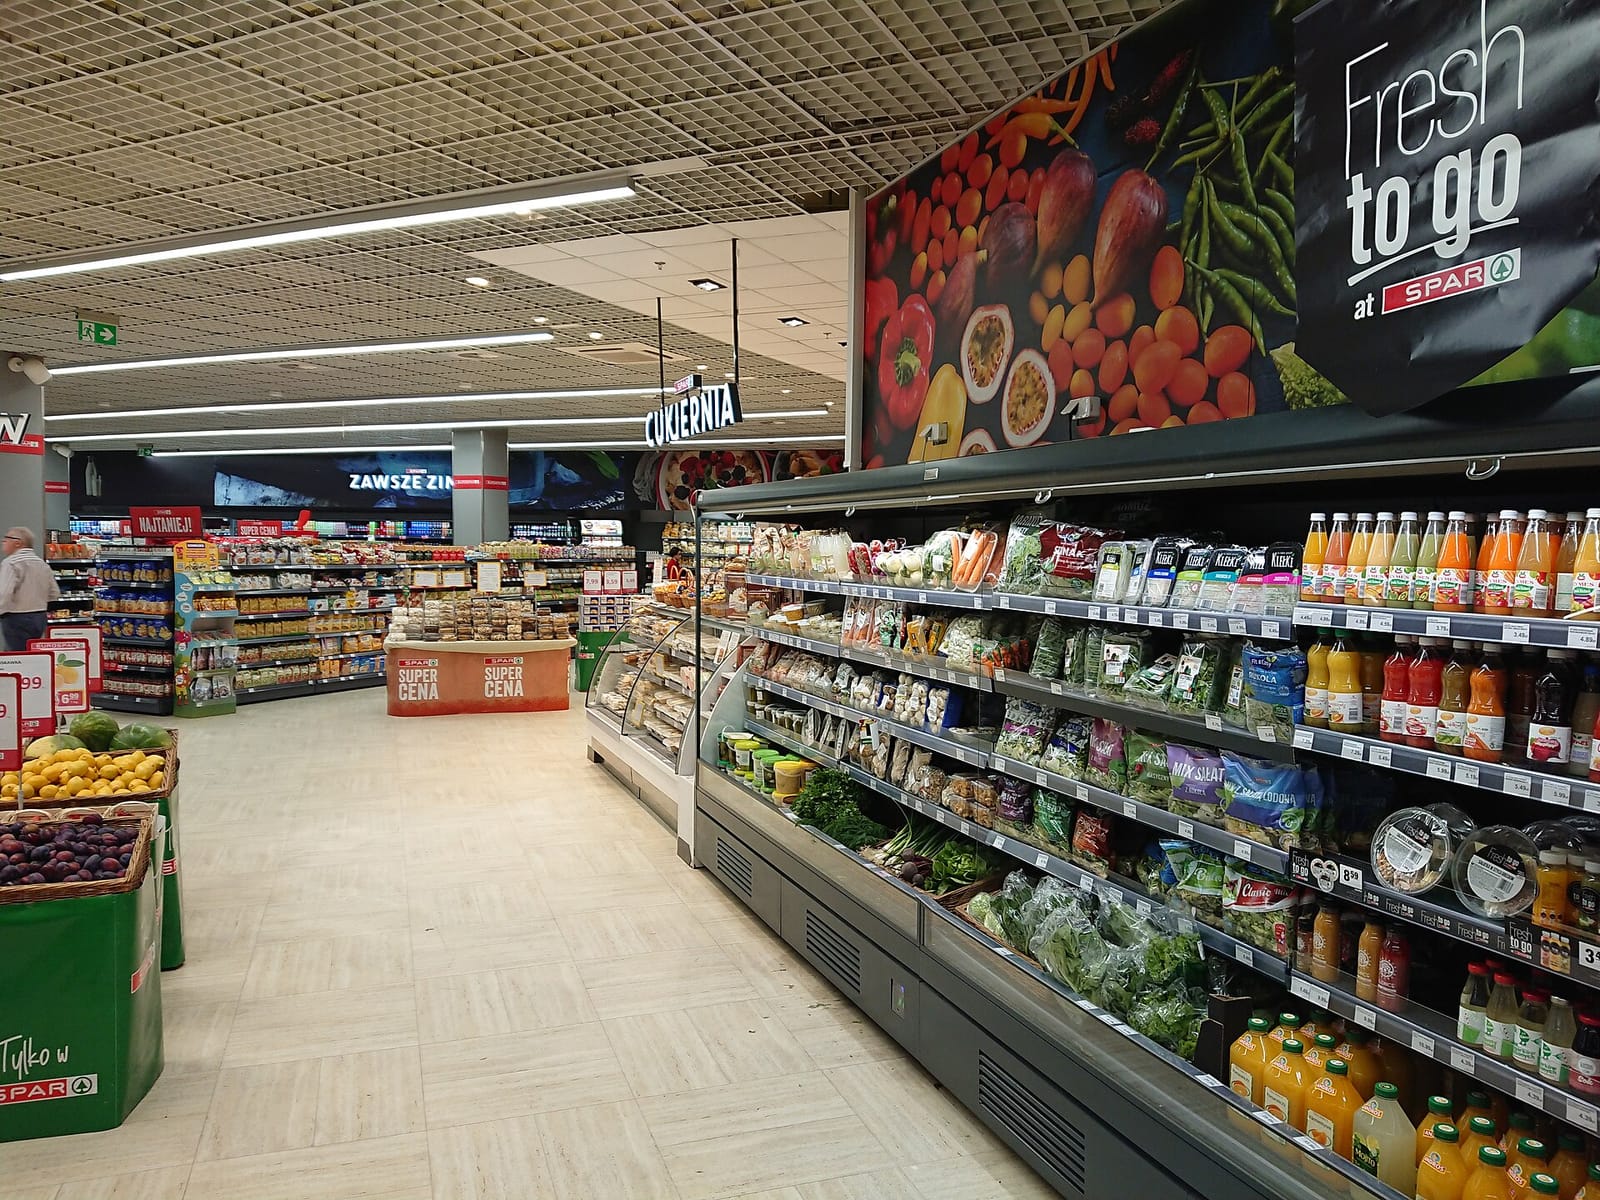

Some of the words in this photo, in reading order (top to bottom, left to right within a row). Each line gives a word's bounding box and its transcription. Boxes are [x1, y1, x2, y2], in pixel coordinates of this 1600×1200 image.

[1345, 0, 1526, 180] Fresh
[1346, 172, 1410, 265] to
[1432, 133, 1523, 260] go
[1353, 292, 1375, 320] at
[1405, 265, 1483, 304] SPAR
[645, 383, 735, 448] CUKIERNIA
[349, 474, 423, 490] ZAWSZE
[139, 516, 192, 533] NAJTANIEJ!
[240, 525, 258, 536] SUPER
[259, 525, 278, 537] CENA!
[398, 668, 437, 683] SUPER
[484, 667, 523, 680] SUPER
[398, 683, 439, 701] CENA
[484, 680, 524, 698] CENA
[1172, 762, 1195, 779] MIX
[1194, 767, 1226, 782] SAŁAT
[1292, 850, 1310, 867] Fresh
[1292, 862, 1300, 874] to
[1300, 866, 1309, 877] go
[1242, 884, 1272, 897] Classic
[1385, 898, 1402, 916] Fresh
[1420, 909, 1438, 927] Fresh
[1457, 922, 1475, 941] Fresh
[1509, 921, 1533, 943] Fresh
[1510, 935, 1520, 949] to
[1520, 940, 1533, 954] go
[0, 1035, 50, 1080] Tylko
[57, 1045, 69, 1063] w
